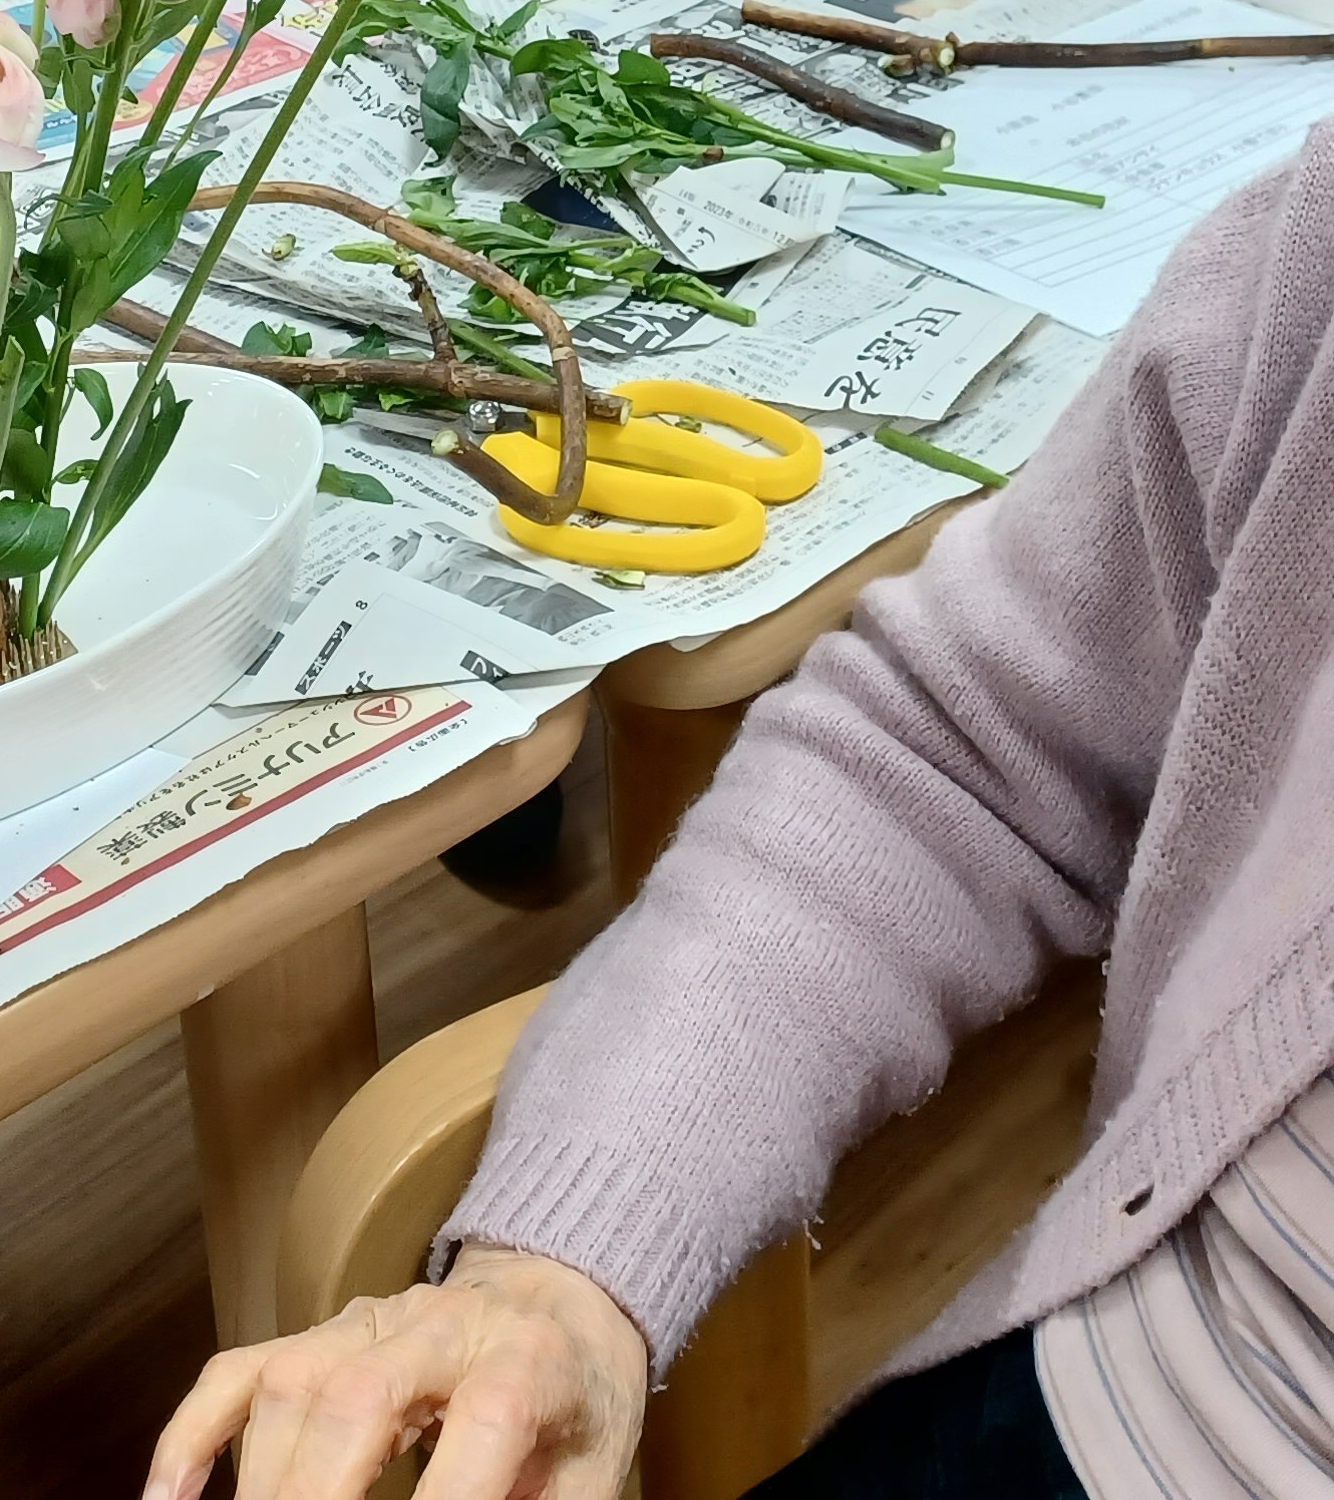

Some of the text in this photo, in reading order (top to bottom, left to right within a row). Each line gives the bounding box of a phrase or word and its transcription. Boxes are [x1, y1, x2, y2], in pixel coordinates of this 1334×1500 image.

[824, 308, 961, 405] 民意を
[298, 622, 350, 691] スポーツ
[95, 714, 355, 863] アリナミン製薬
